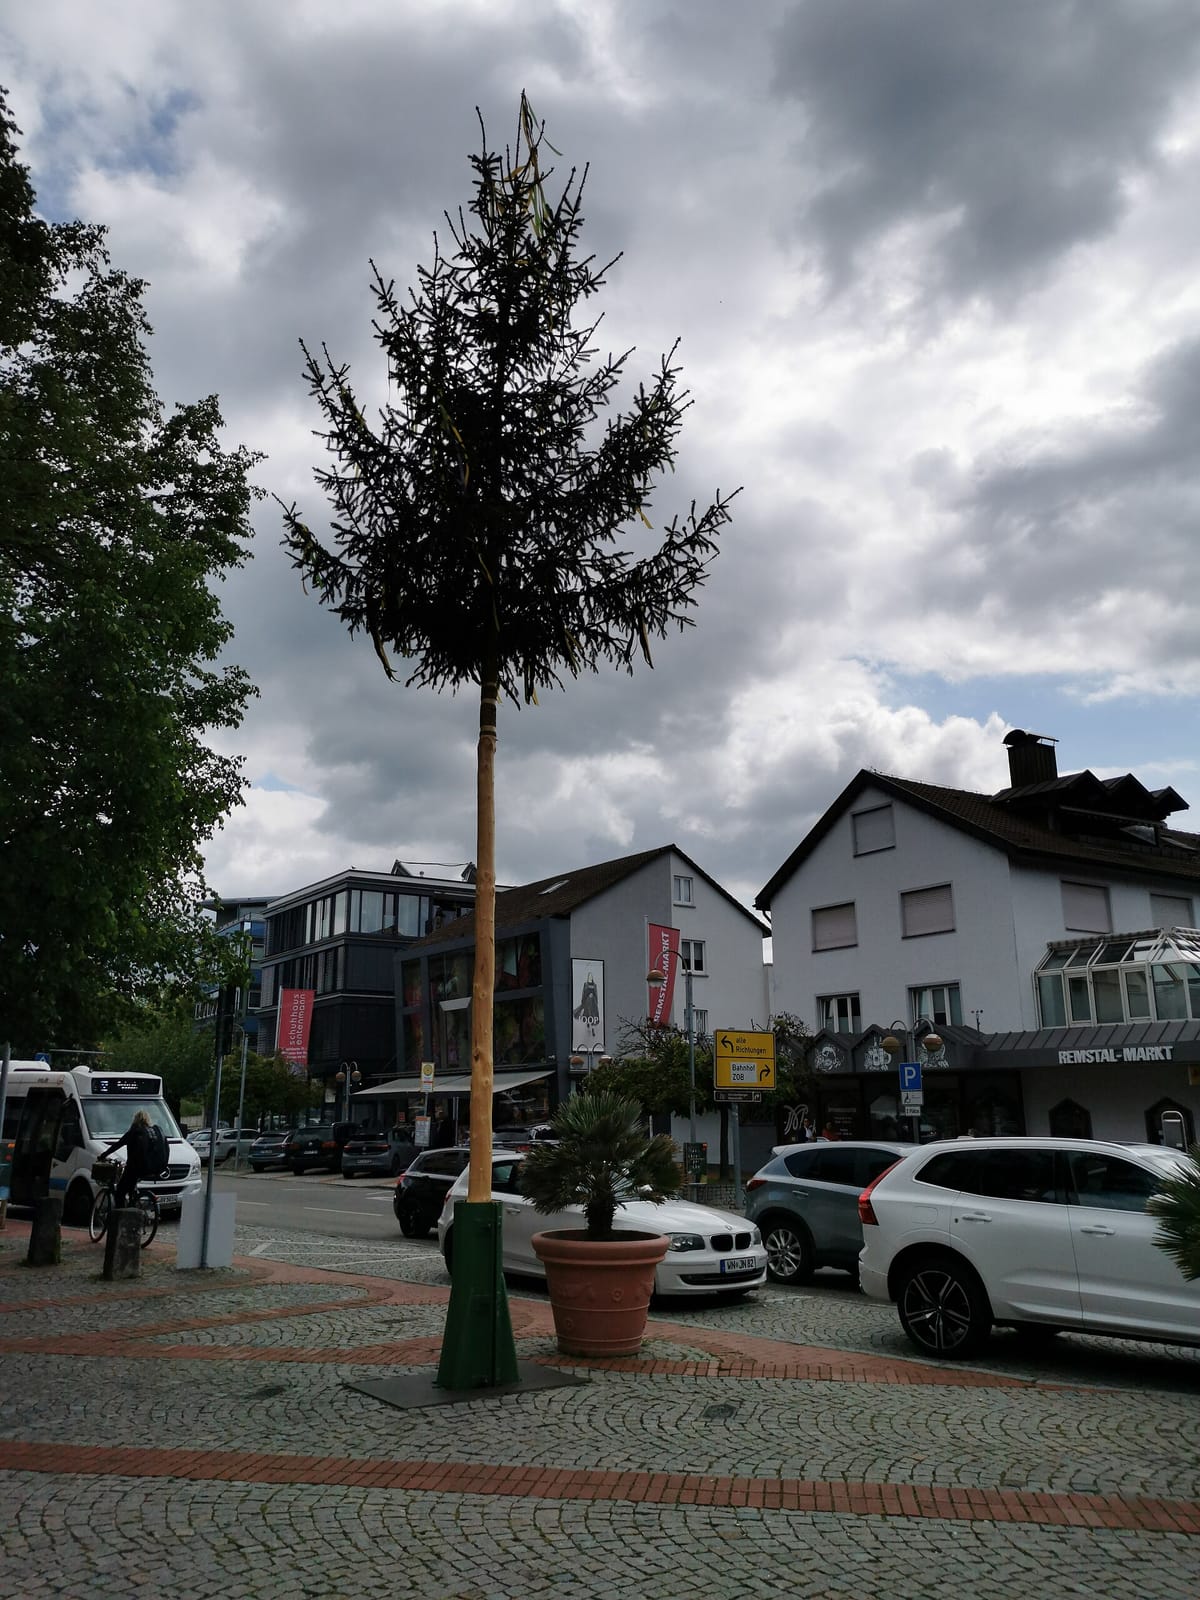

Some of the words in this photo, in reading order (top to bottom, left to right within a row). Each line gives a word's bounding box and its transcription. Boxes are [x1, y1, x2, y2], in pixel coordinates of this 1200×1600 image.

[736, 1046, 767, 1055] Richtungen
[1058, 1046, 1174, 1065] REMSTAL-MARKT
[732, 1063, 756, 1072] Bahnhof
[904, 1066, 916, 1087] P
